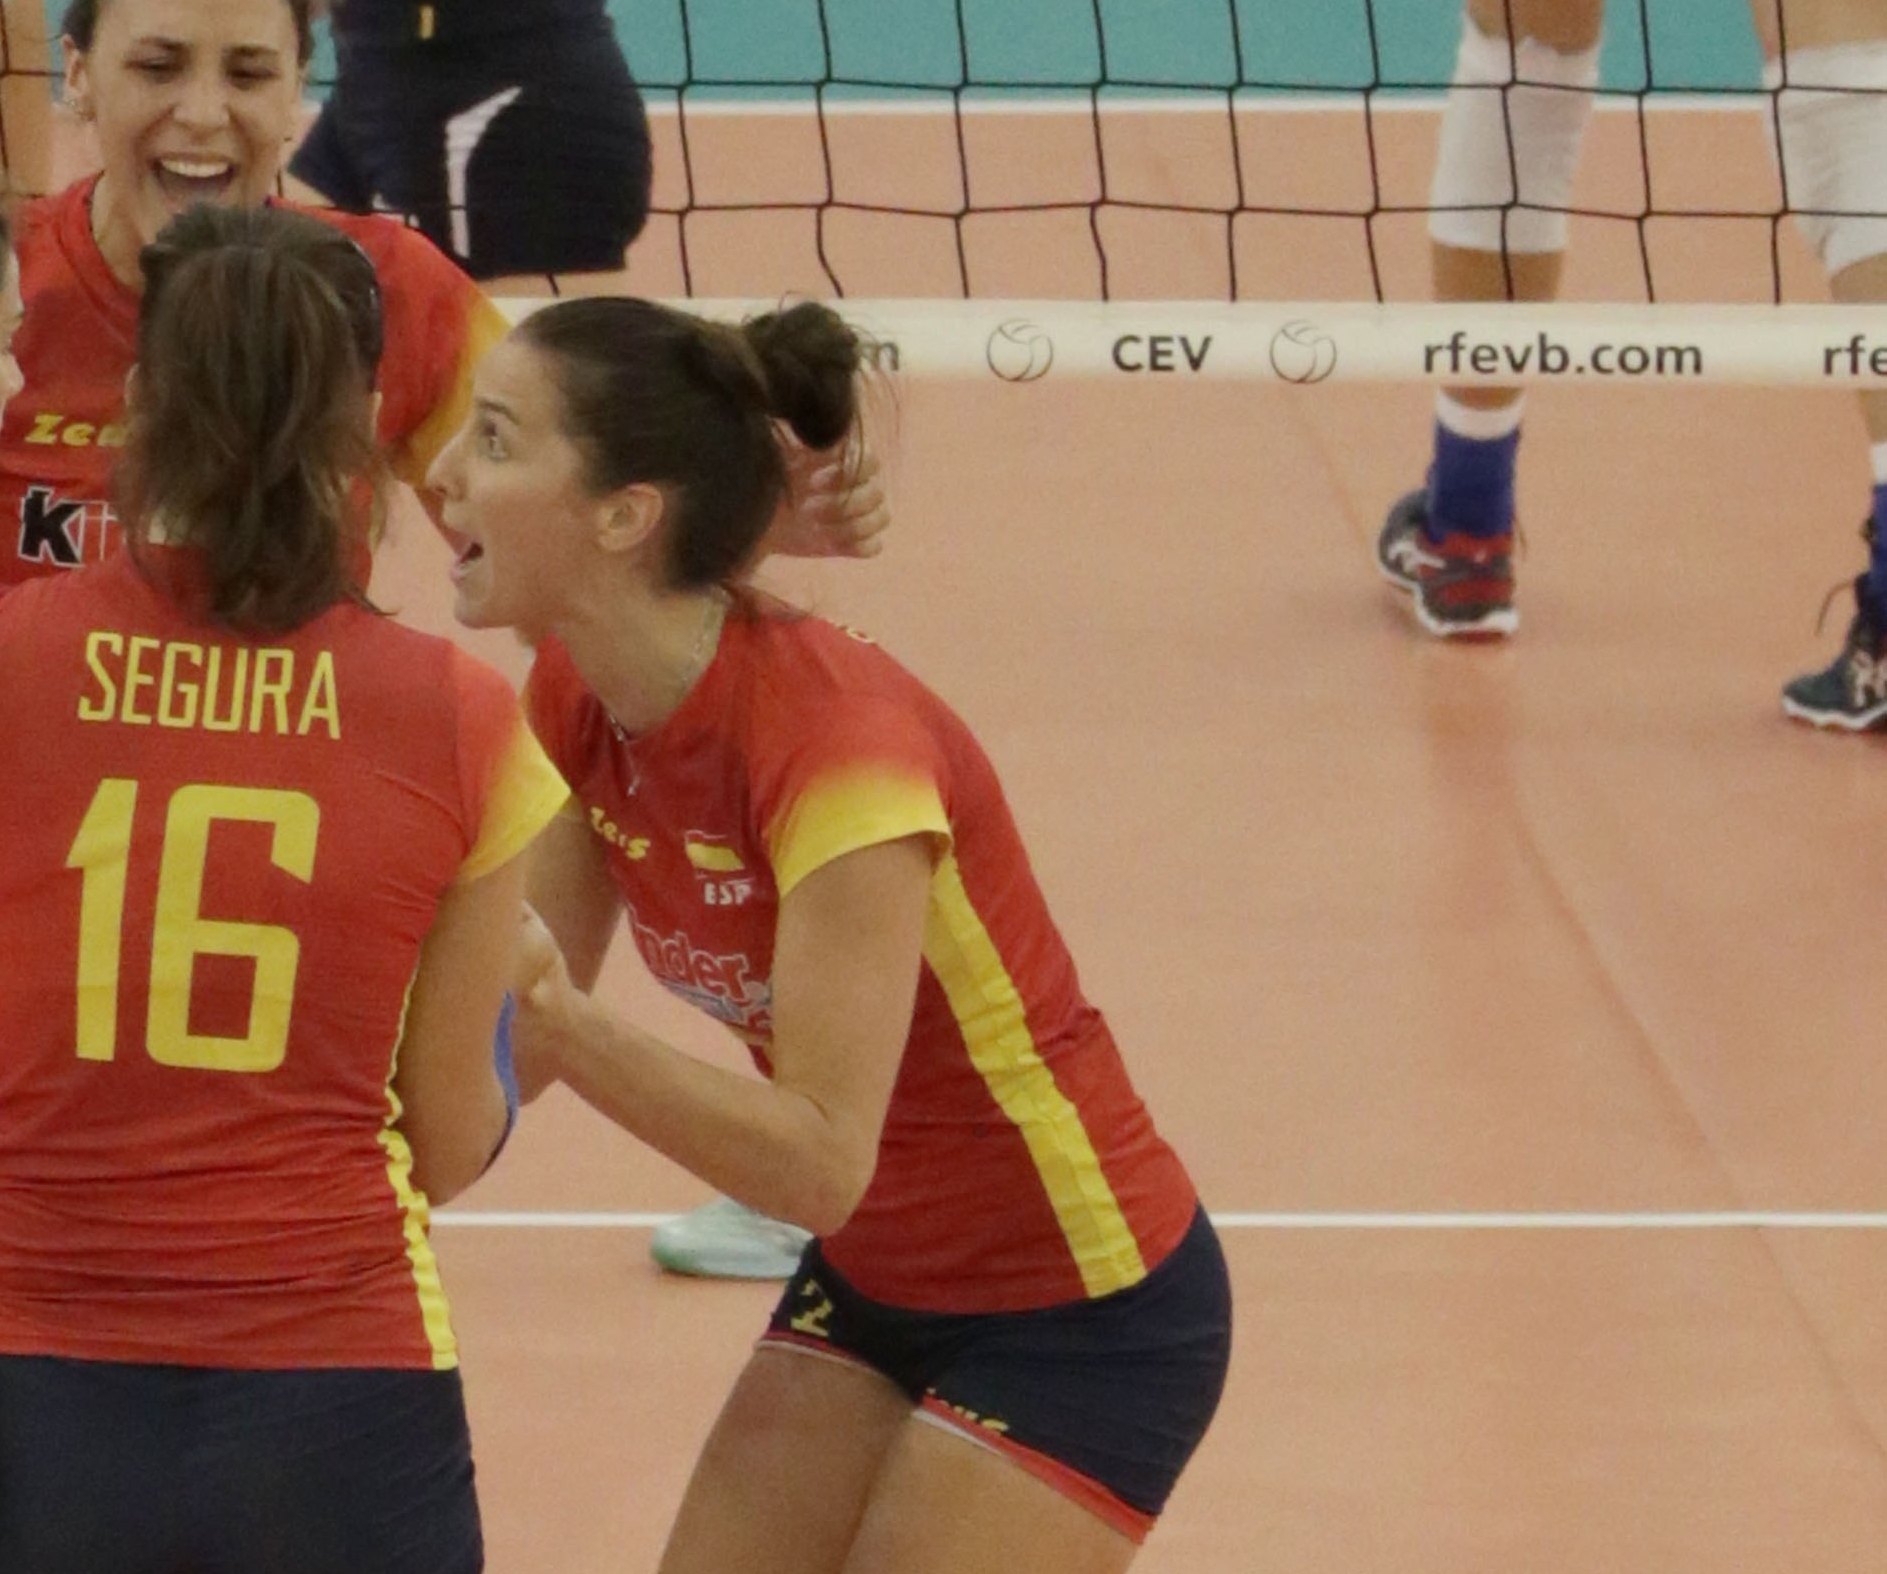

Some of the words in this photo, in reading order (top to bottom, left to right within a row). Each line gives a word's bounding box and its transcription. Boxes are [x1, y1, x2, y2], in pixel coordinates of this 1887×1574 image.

[1110, 333, 1213, 375] CEV
[1423, 330, 1704, 377] rfevb.com
[77, 631, 342, 740] SEGURA
[65, 777, 321, 1073] 16
[704, 882, 753, 906] ESP
